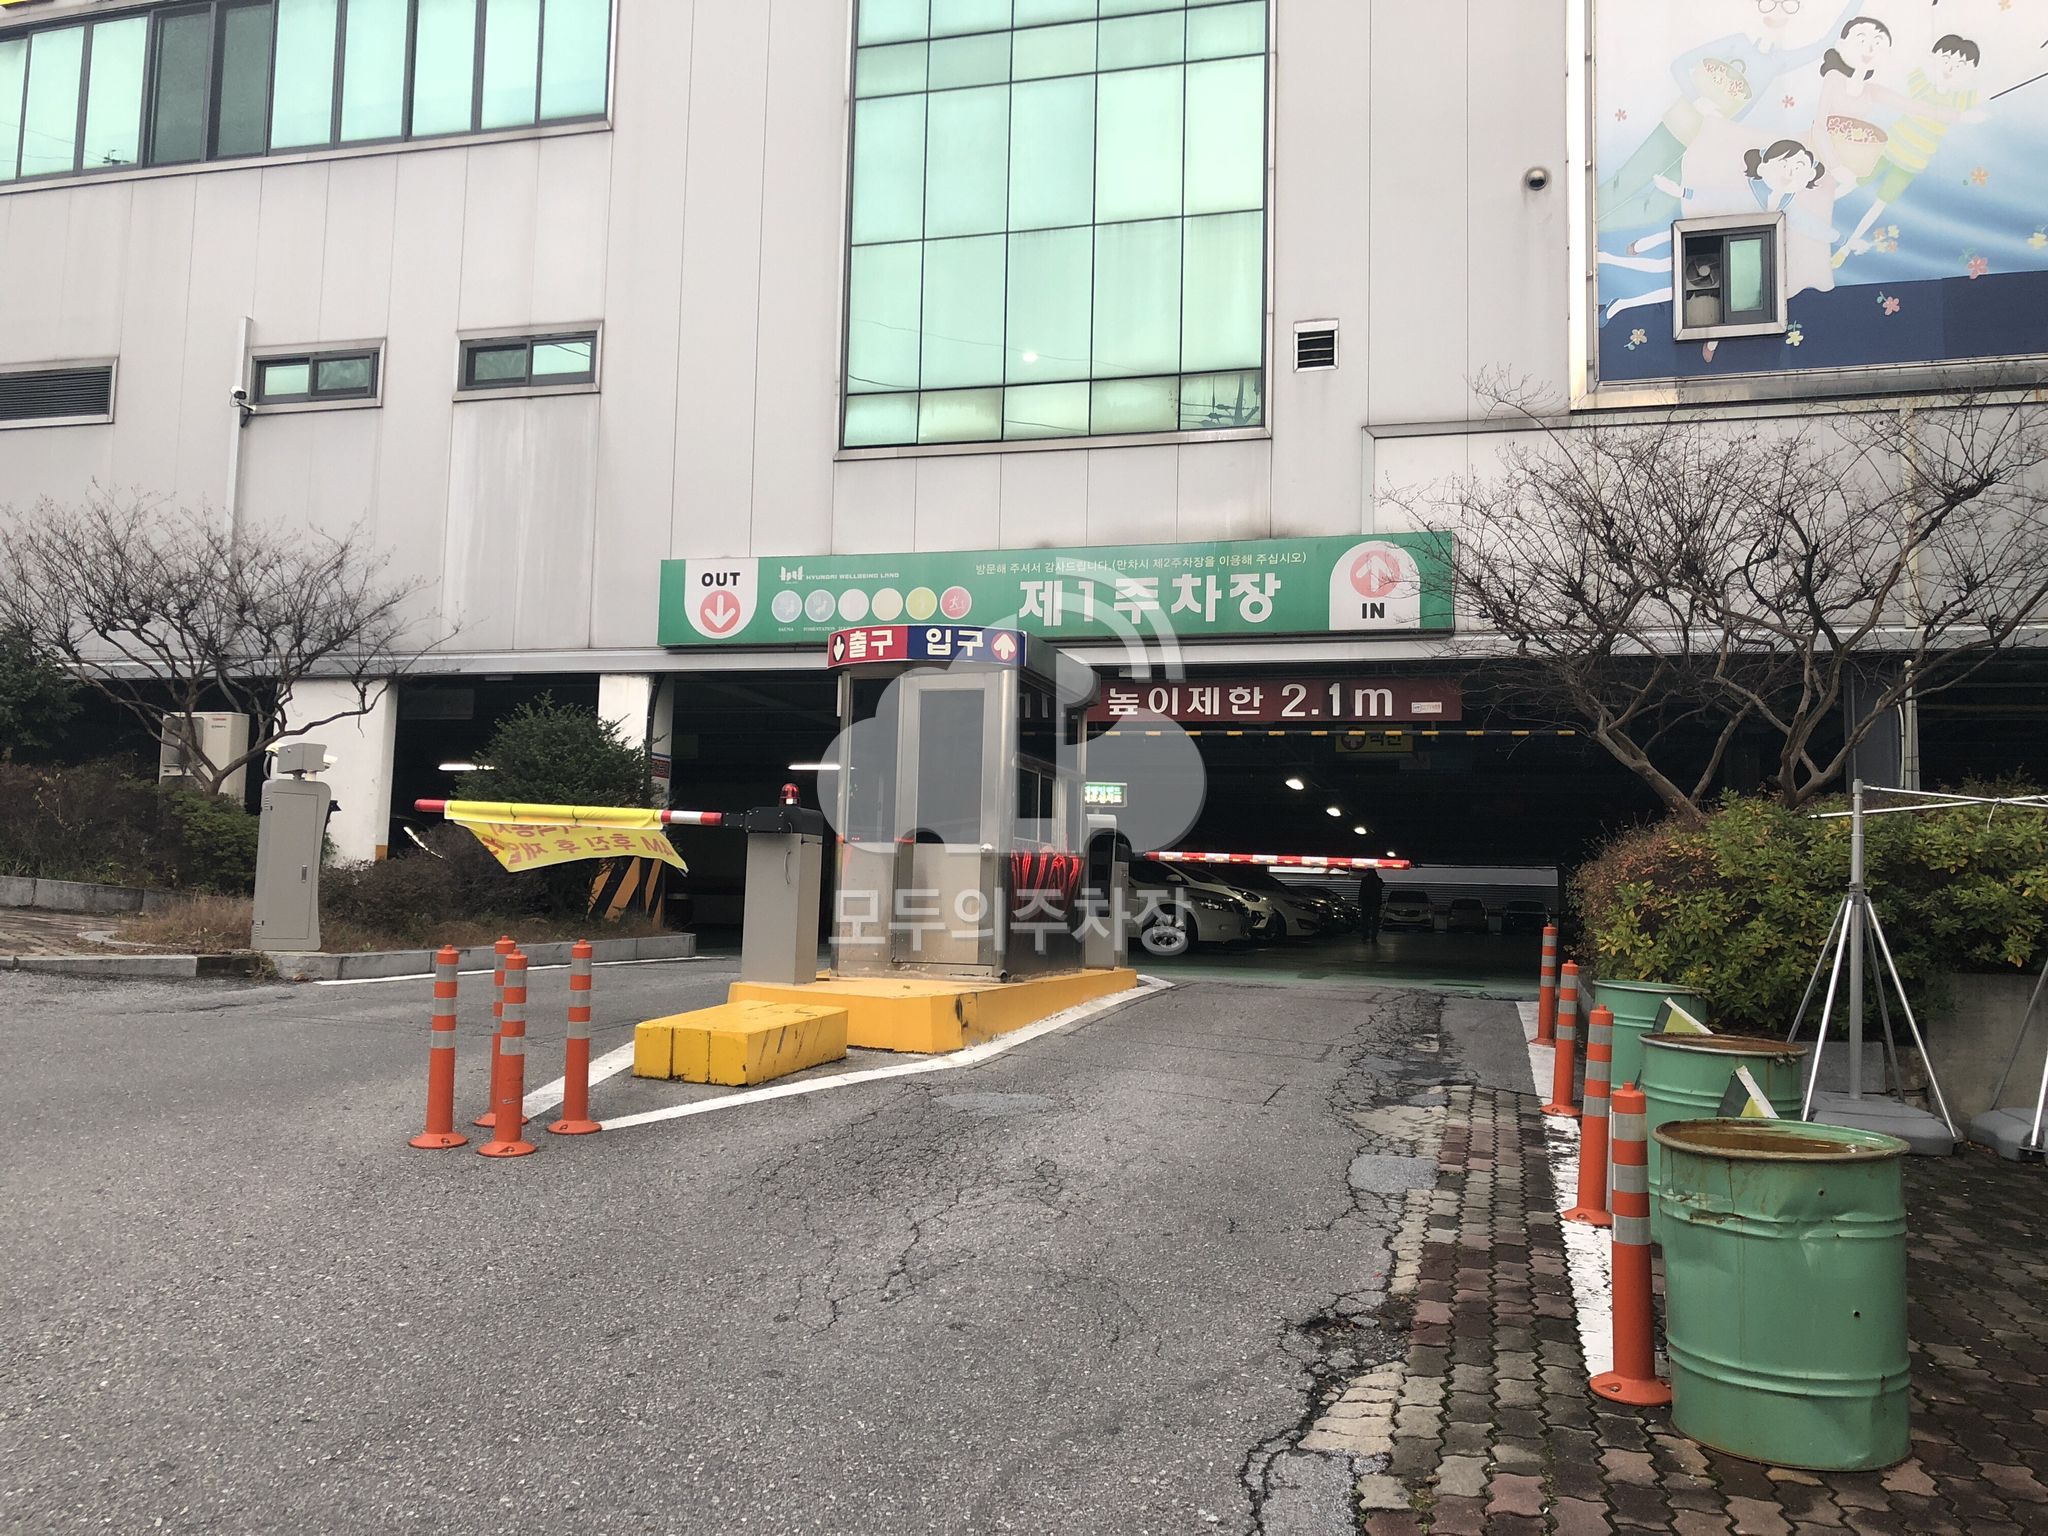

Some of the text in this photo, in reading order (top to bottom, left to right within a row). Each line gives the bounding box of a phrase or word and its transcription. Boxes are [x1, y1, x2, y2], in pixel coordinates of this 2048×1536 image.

[975, 562, 1007, 576] 방문해
[1010, 561, 1041, 574] 주셔서
[1152, 555, 1216, 569] 제2주차장을
[1219, 554, 1252, 567] 이용해
[1255, 551, 1307, 565] 주십시오)
[701, 572, 741, 587] OUT
[1361, 603, 1385, 619] IN
[850, 629, 893, 659] 출구
[925, 628, 984, 657] 입구
[1107, 683, 1393, 717] 높이제한 2.1m
